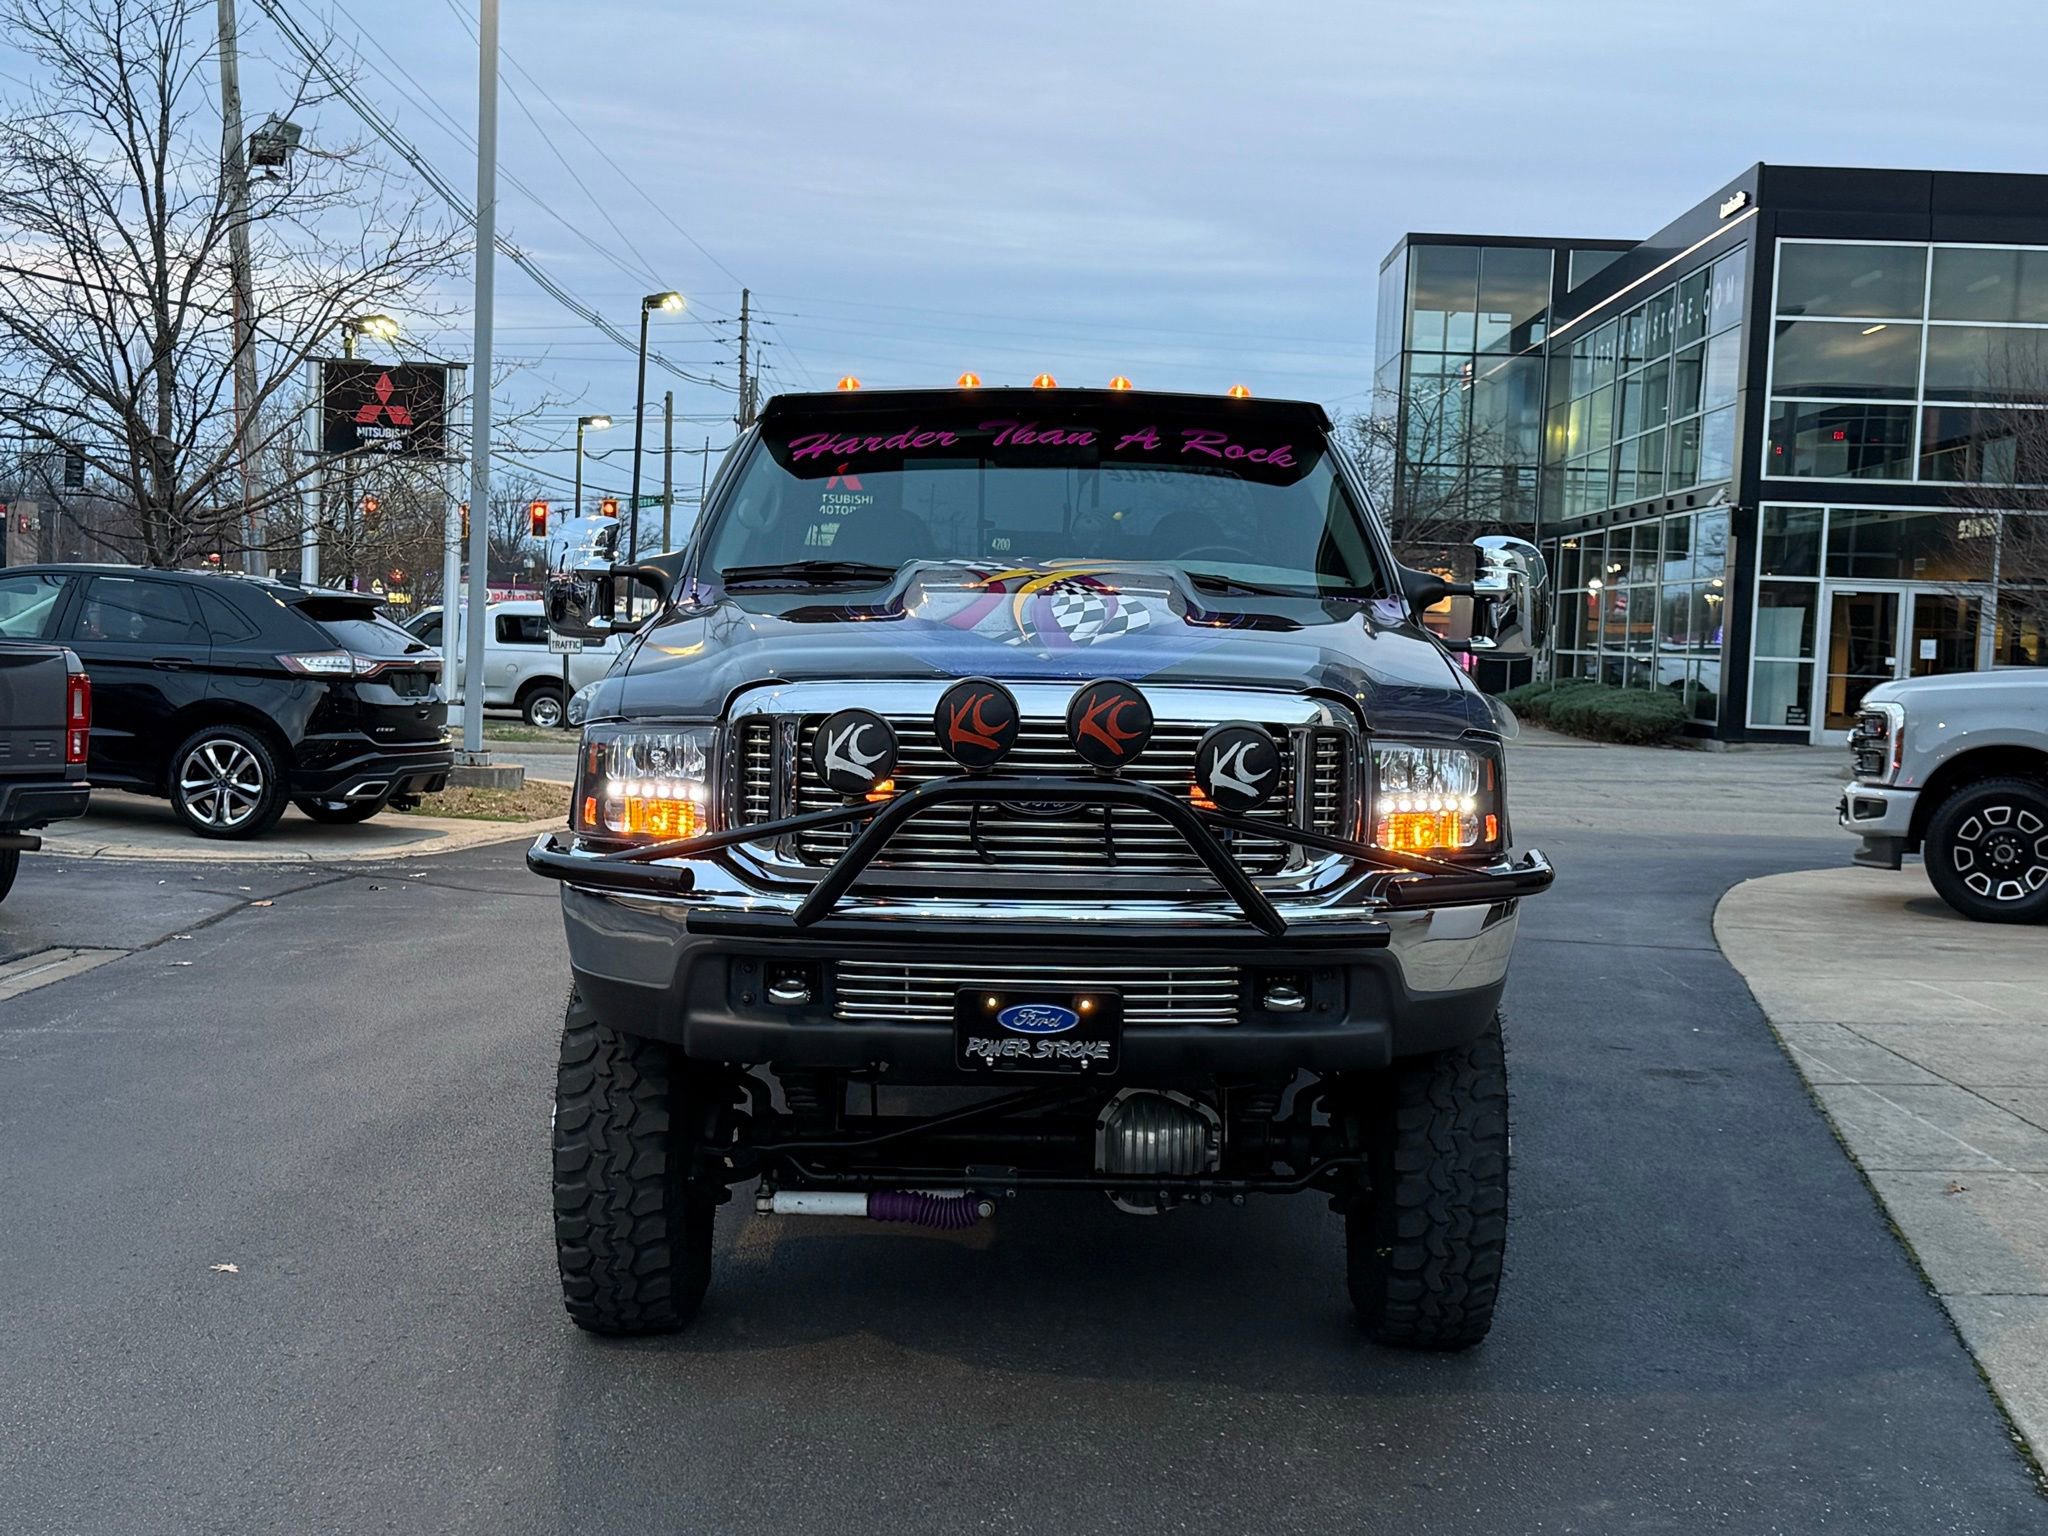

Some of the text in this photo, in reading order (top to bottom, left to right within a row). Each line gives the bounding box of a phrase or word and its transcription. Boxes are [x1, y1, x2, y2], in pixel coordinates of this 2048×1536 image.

[364, 438, 402, 450] MOORS
[788, 420, 1297, 467] Harder Than A Rock
[822, 493, 873, 504] TSUBISHI
[552, 640, 580, 649] TRAFFIC
[948, 694, 1009, 753] KC
[1076, 694, 1142, 755] KC
[824, 722, 887, 781] KC
[1208, 740, 1272, 797] KC
[1013, 1008, 1064, 1029] Ford
[965, 1036, 1111, 1060] POWER STROKE
